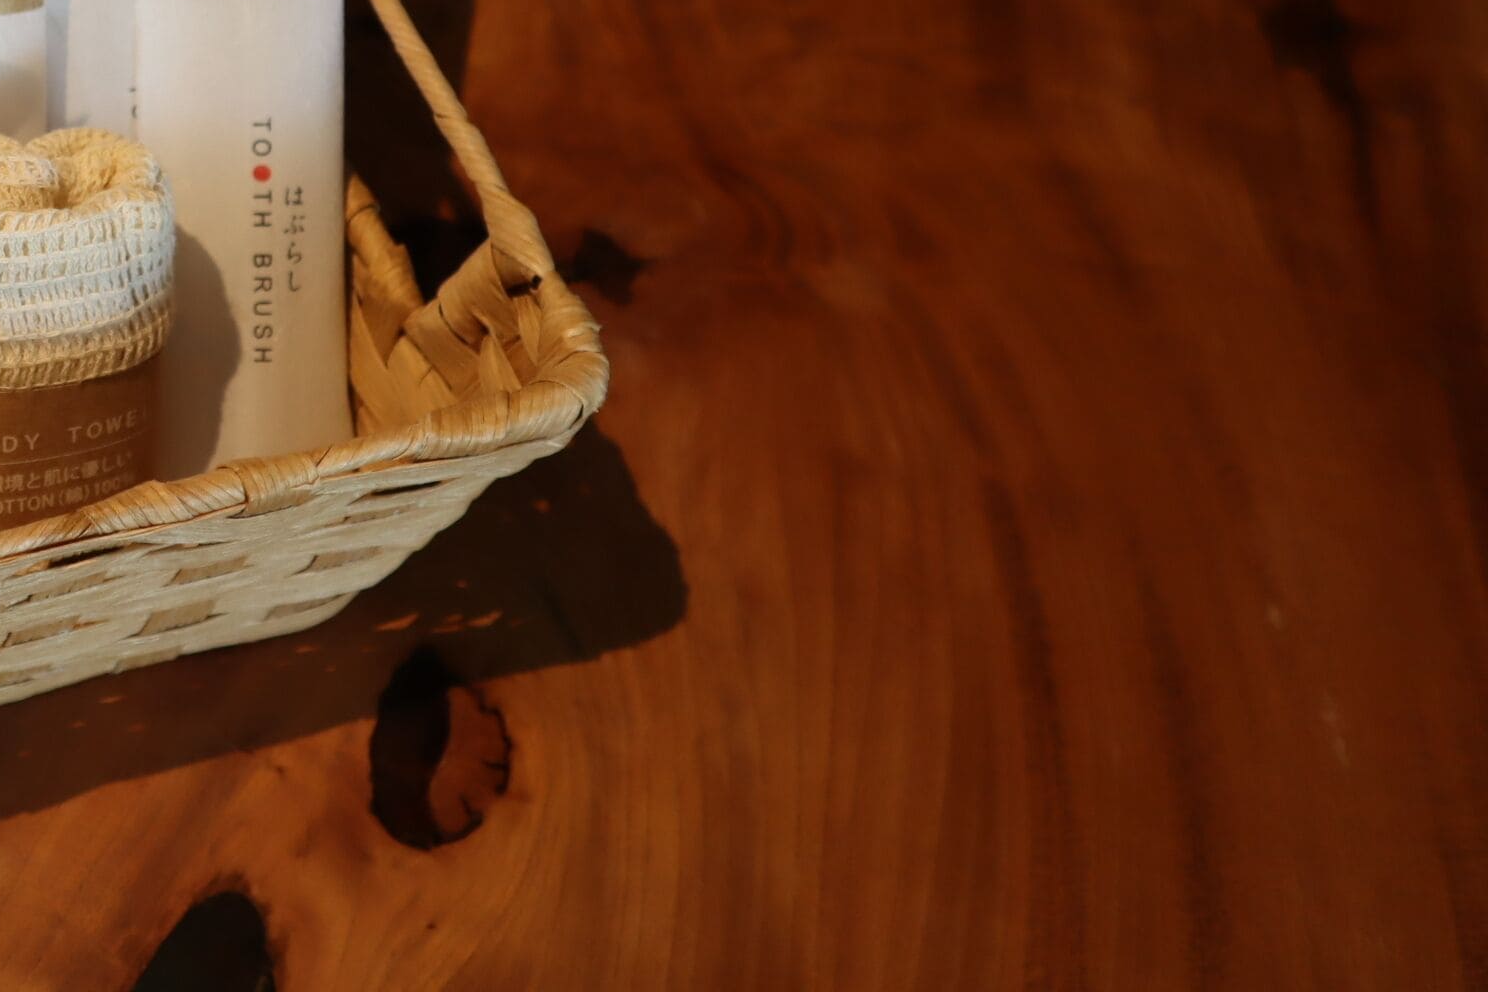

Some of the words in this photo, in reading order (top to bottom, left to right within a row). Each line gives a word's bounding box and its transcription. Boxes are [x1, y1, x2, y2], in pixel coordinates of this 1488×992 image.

[283, 186, 306, 293] はぶらし
[252, 253, 273, 364] BRUSH
